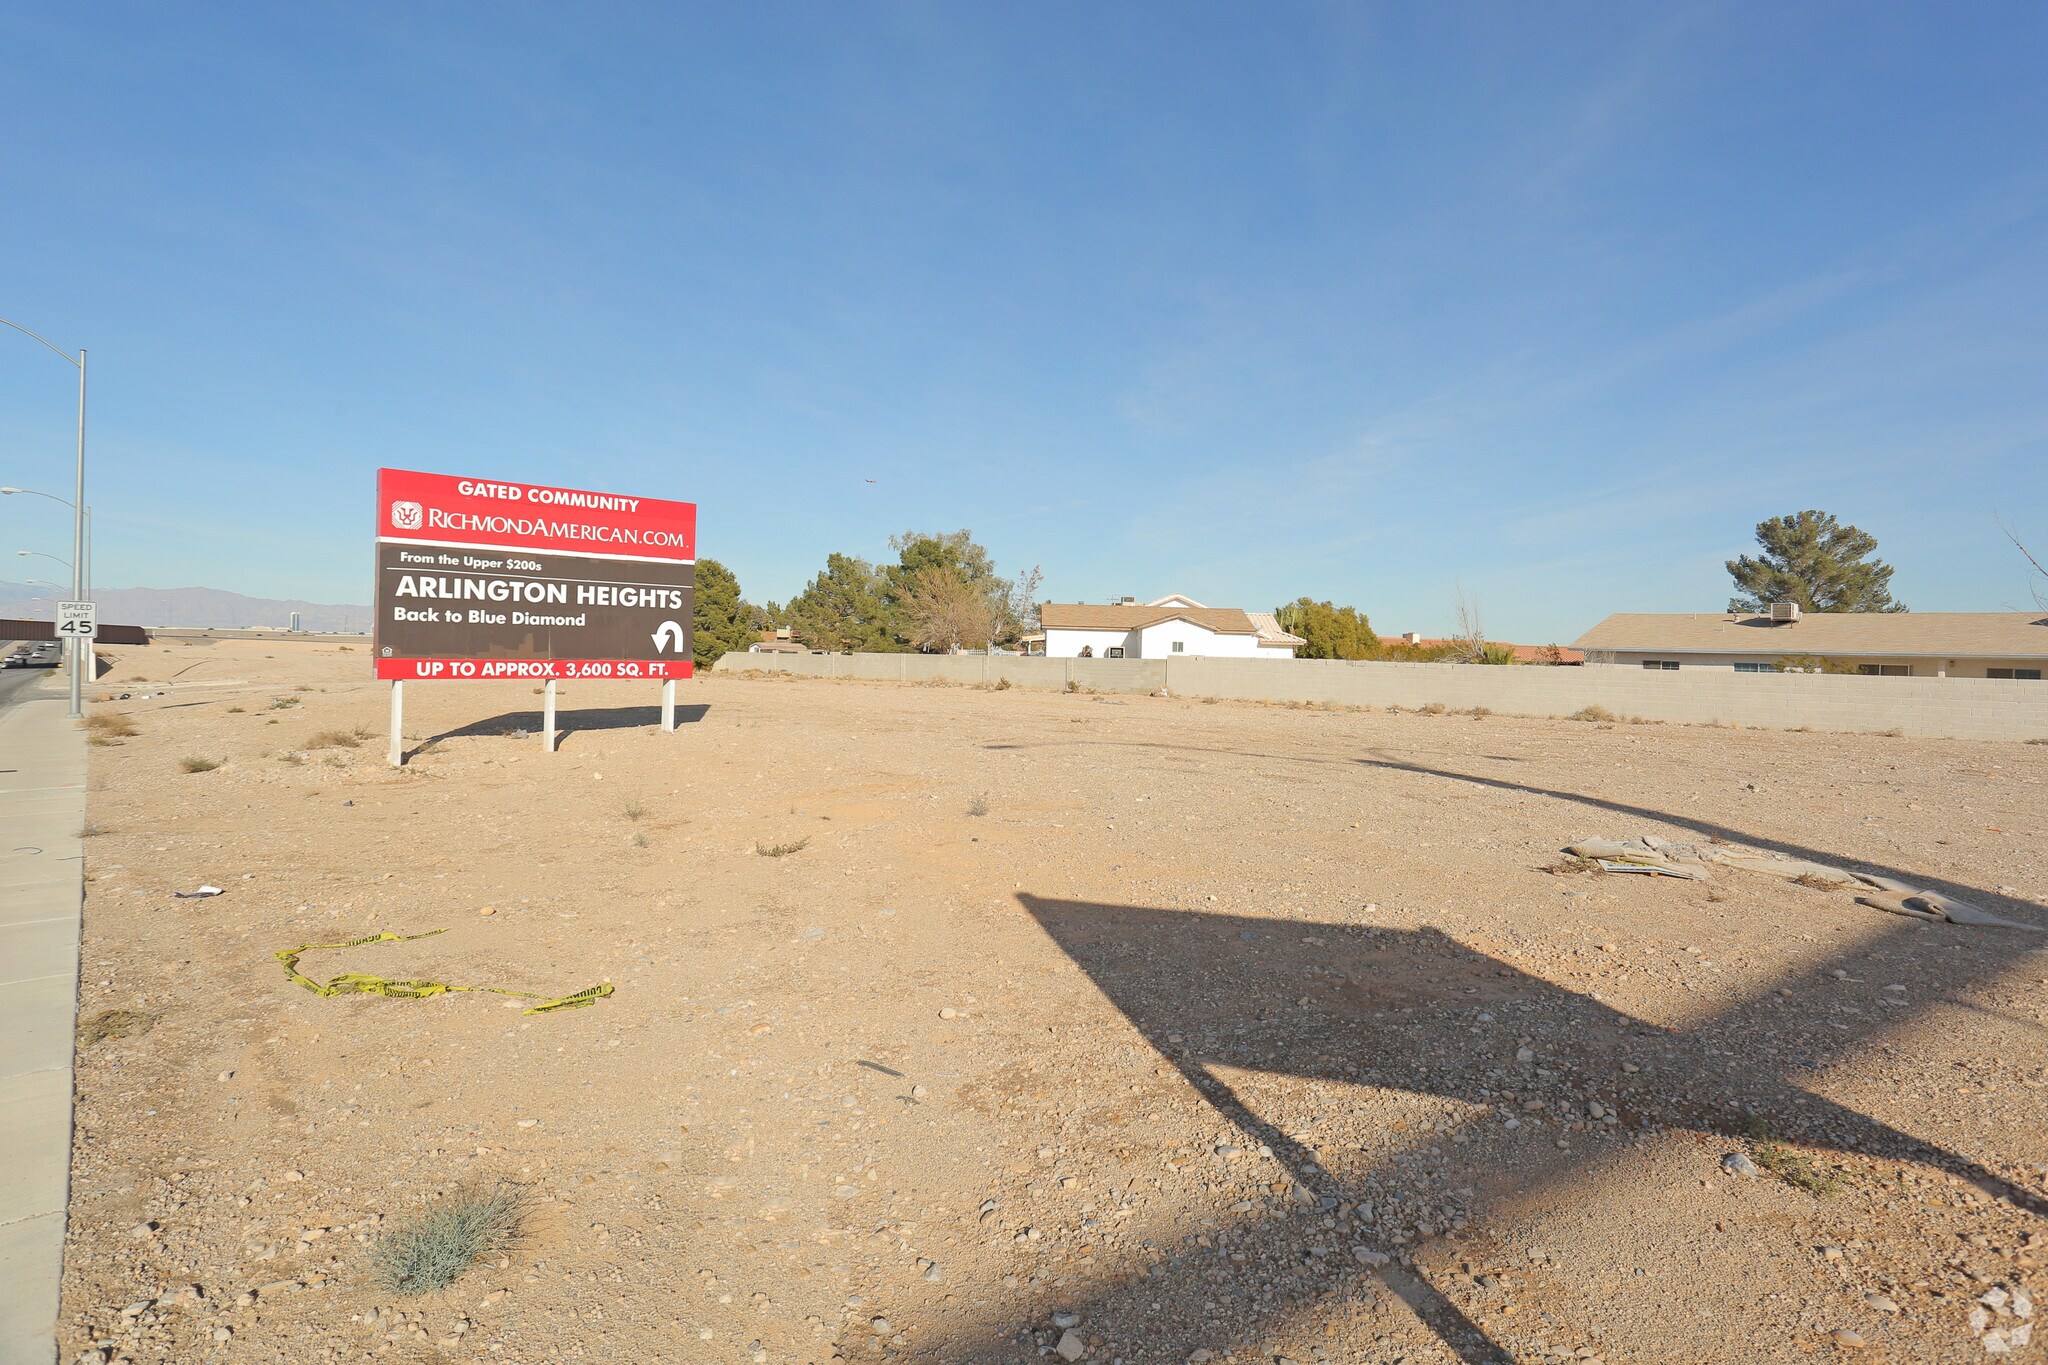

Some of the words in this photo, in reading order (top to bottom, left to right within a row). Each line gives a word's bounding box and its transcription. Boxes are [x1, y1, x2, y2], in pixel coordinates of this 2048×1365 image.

[457, 480, 522, 501] GATED
[527, 488, 640, 513] COMMUNITY
[400, 551, 435, 564] From
[437, 553, 460, 566] the
[463, 555, 504, 570] Upper
[506, 558, 542, 571] $200s
[395, 575, 567, 604] ARLINGTON
[576, 585, 683, 610] HEIGHTS
[61, 603, 92, 611] SPEED
[394, 606, 440, 623] Back
[444, 610, 463, 623] to
[468, 609, 507, 625] Blue
[512, 611, 586, 627] Diamond
[60, 620, 92, 634] 45
[416, 661, 444, 677] UP
[449, 661, 476, 677] TO
[480, 662, 560, 677] APPROX.
[565, 662, 612, 679] 3,600
[616, 662, 644, 677] SQ.
[648, 662, 670, 677] FT.
